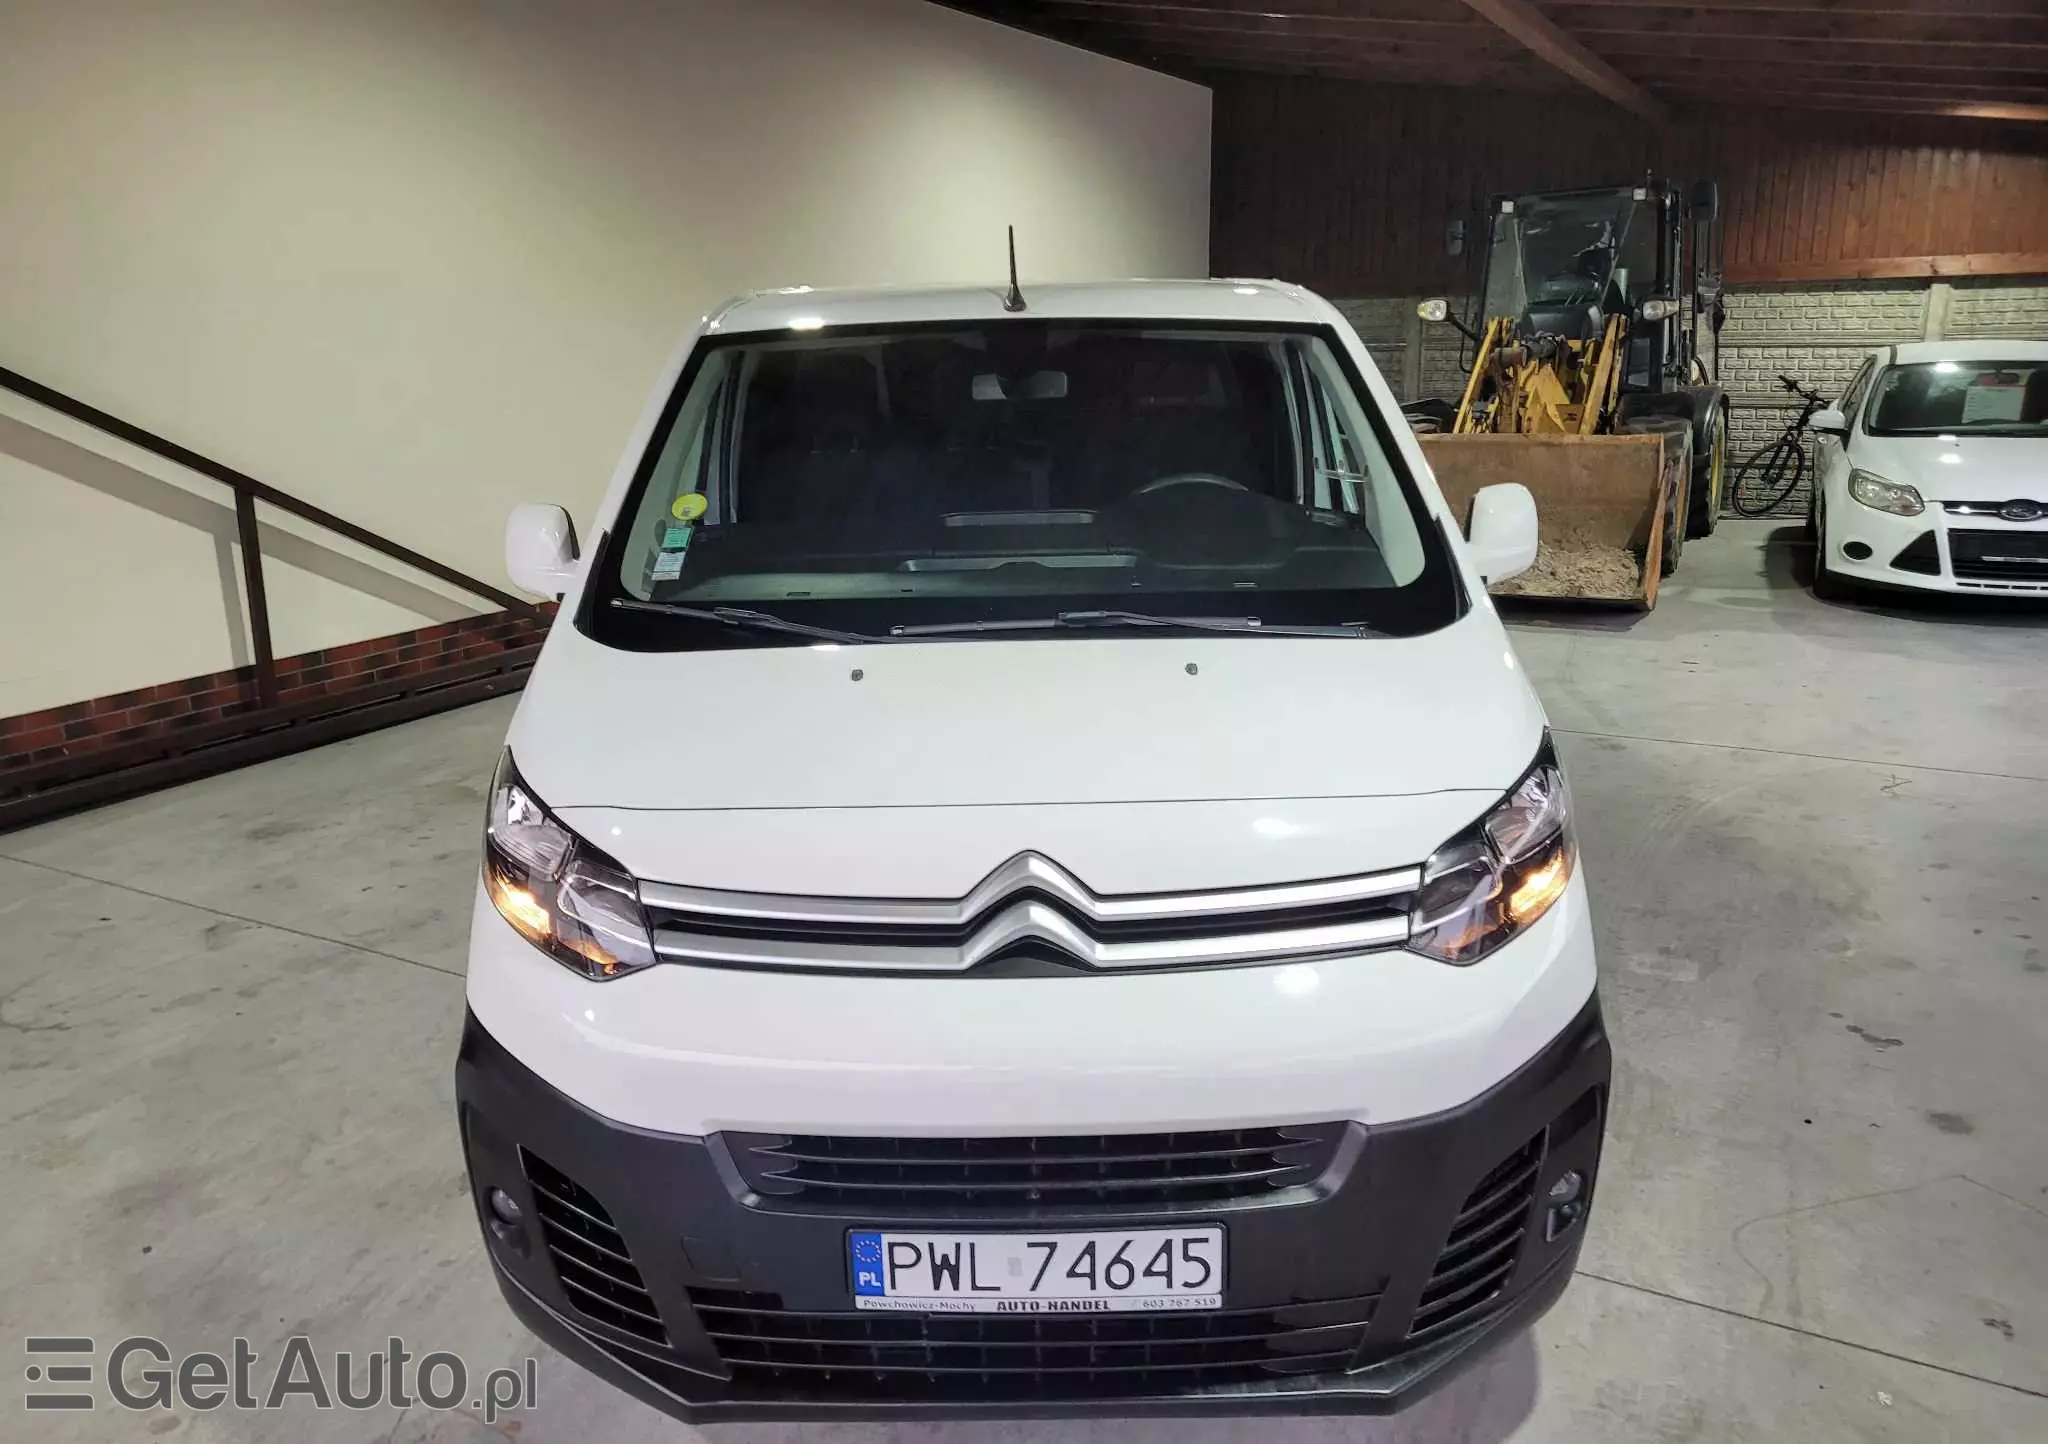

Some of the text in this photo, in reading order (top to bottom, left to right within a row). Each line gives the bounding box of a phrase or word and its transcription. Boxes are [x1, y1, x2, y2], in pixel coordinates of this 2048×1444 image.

[858, 1271, 882, 1287] PL
[887, 1237, 1211, 1291] PWL 74645
